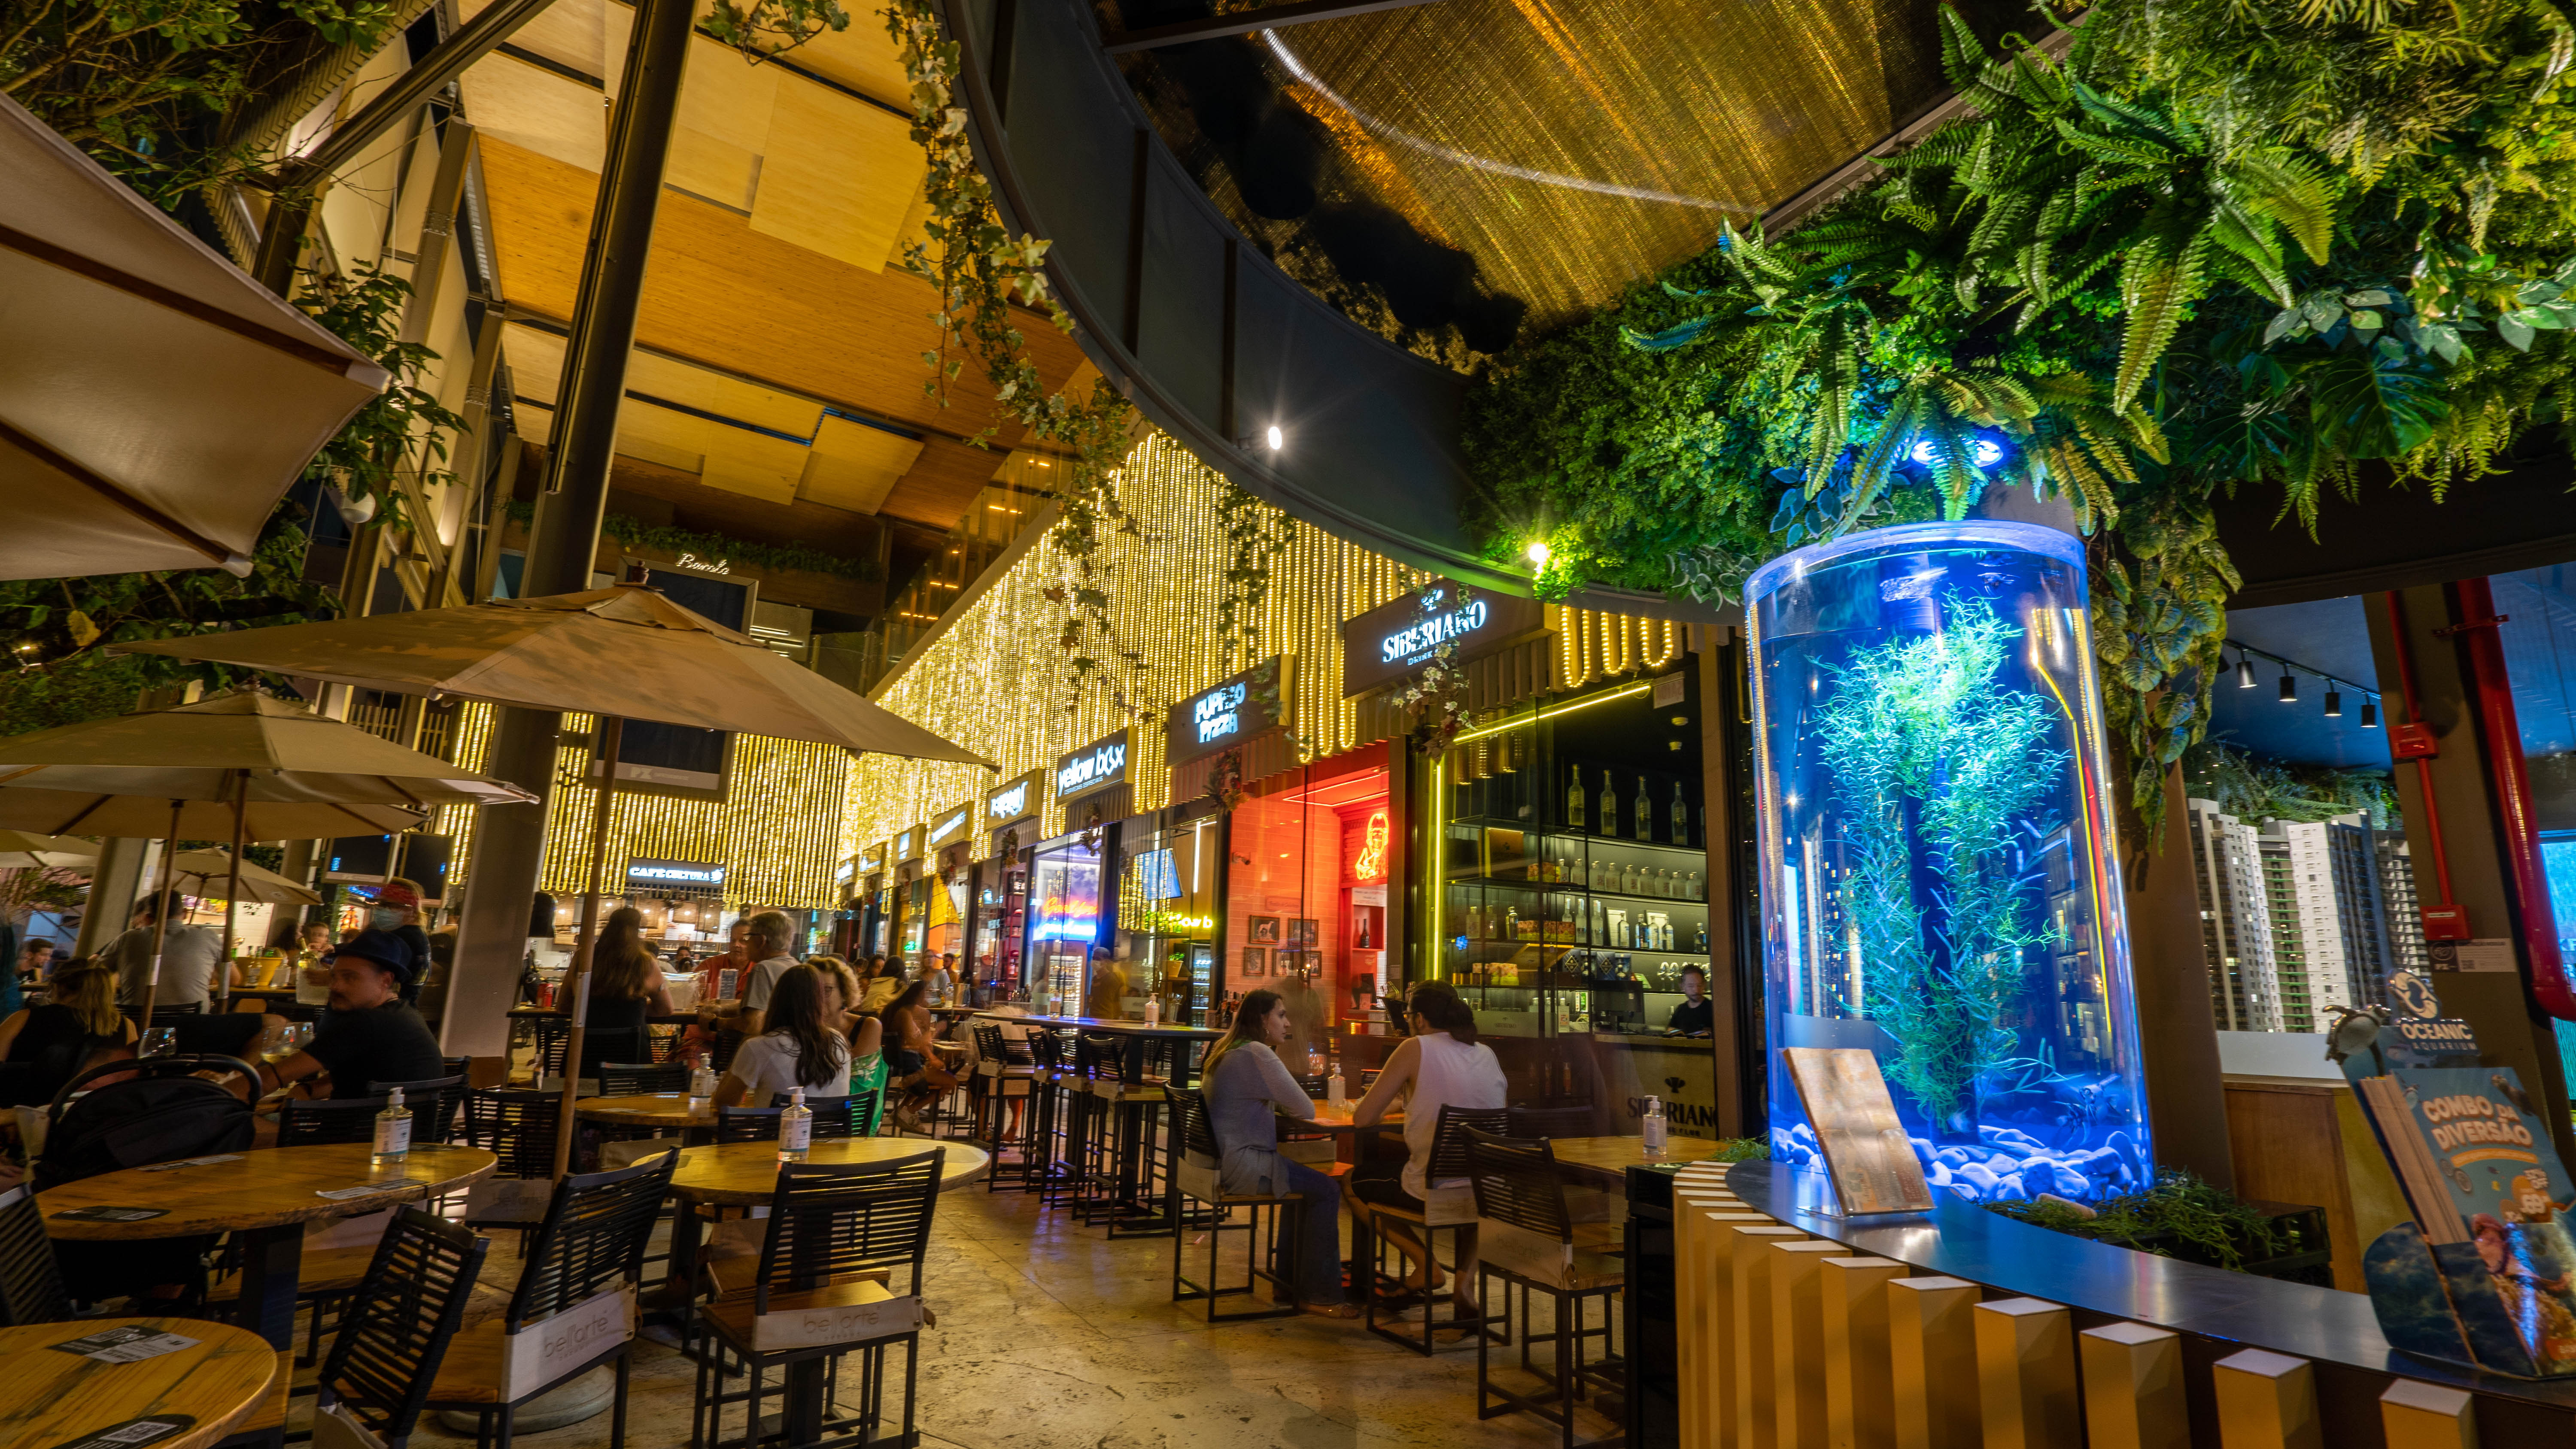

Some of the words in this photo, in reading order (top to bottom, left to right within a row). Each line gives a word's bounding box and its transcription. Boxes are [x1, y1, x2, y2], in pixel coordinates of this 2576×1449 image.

[1383, 601, 1486, 662] SIBERIANO
[1058, 757, 1096, 797] yellow
[1096, 744, 1125, 776] box
[2401, 1024, 2473, 1040] OCEANIC
[2412, 1042, 2478, 1051] AQUARIUM
[2422, 1094, 2494, 1123] COMBO
[2495, 1103, 2521, 1123] DA
[2431, 1117, 2533, 1152] DIVERSÃO
